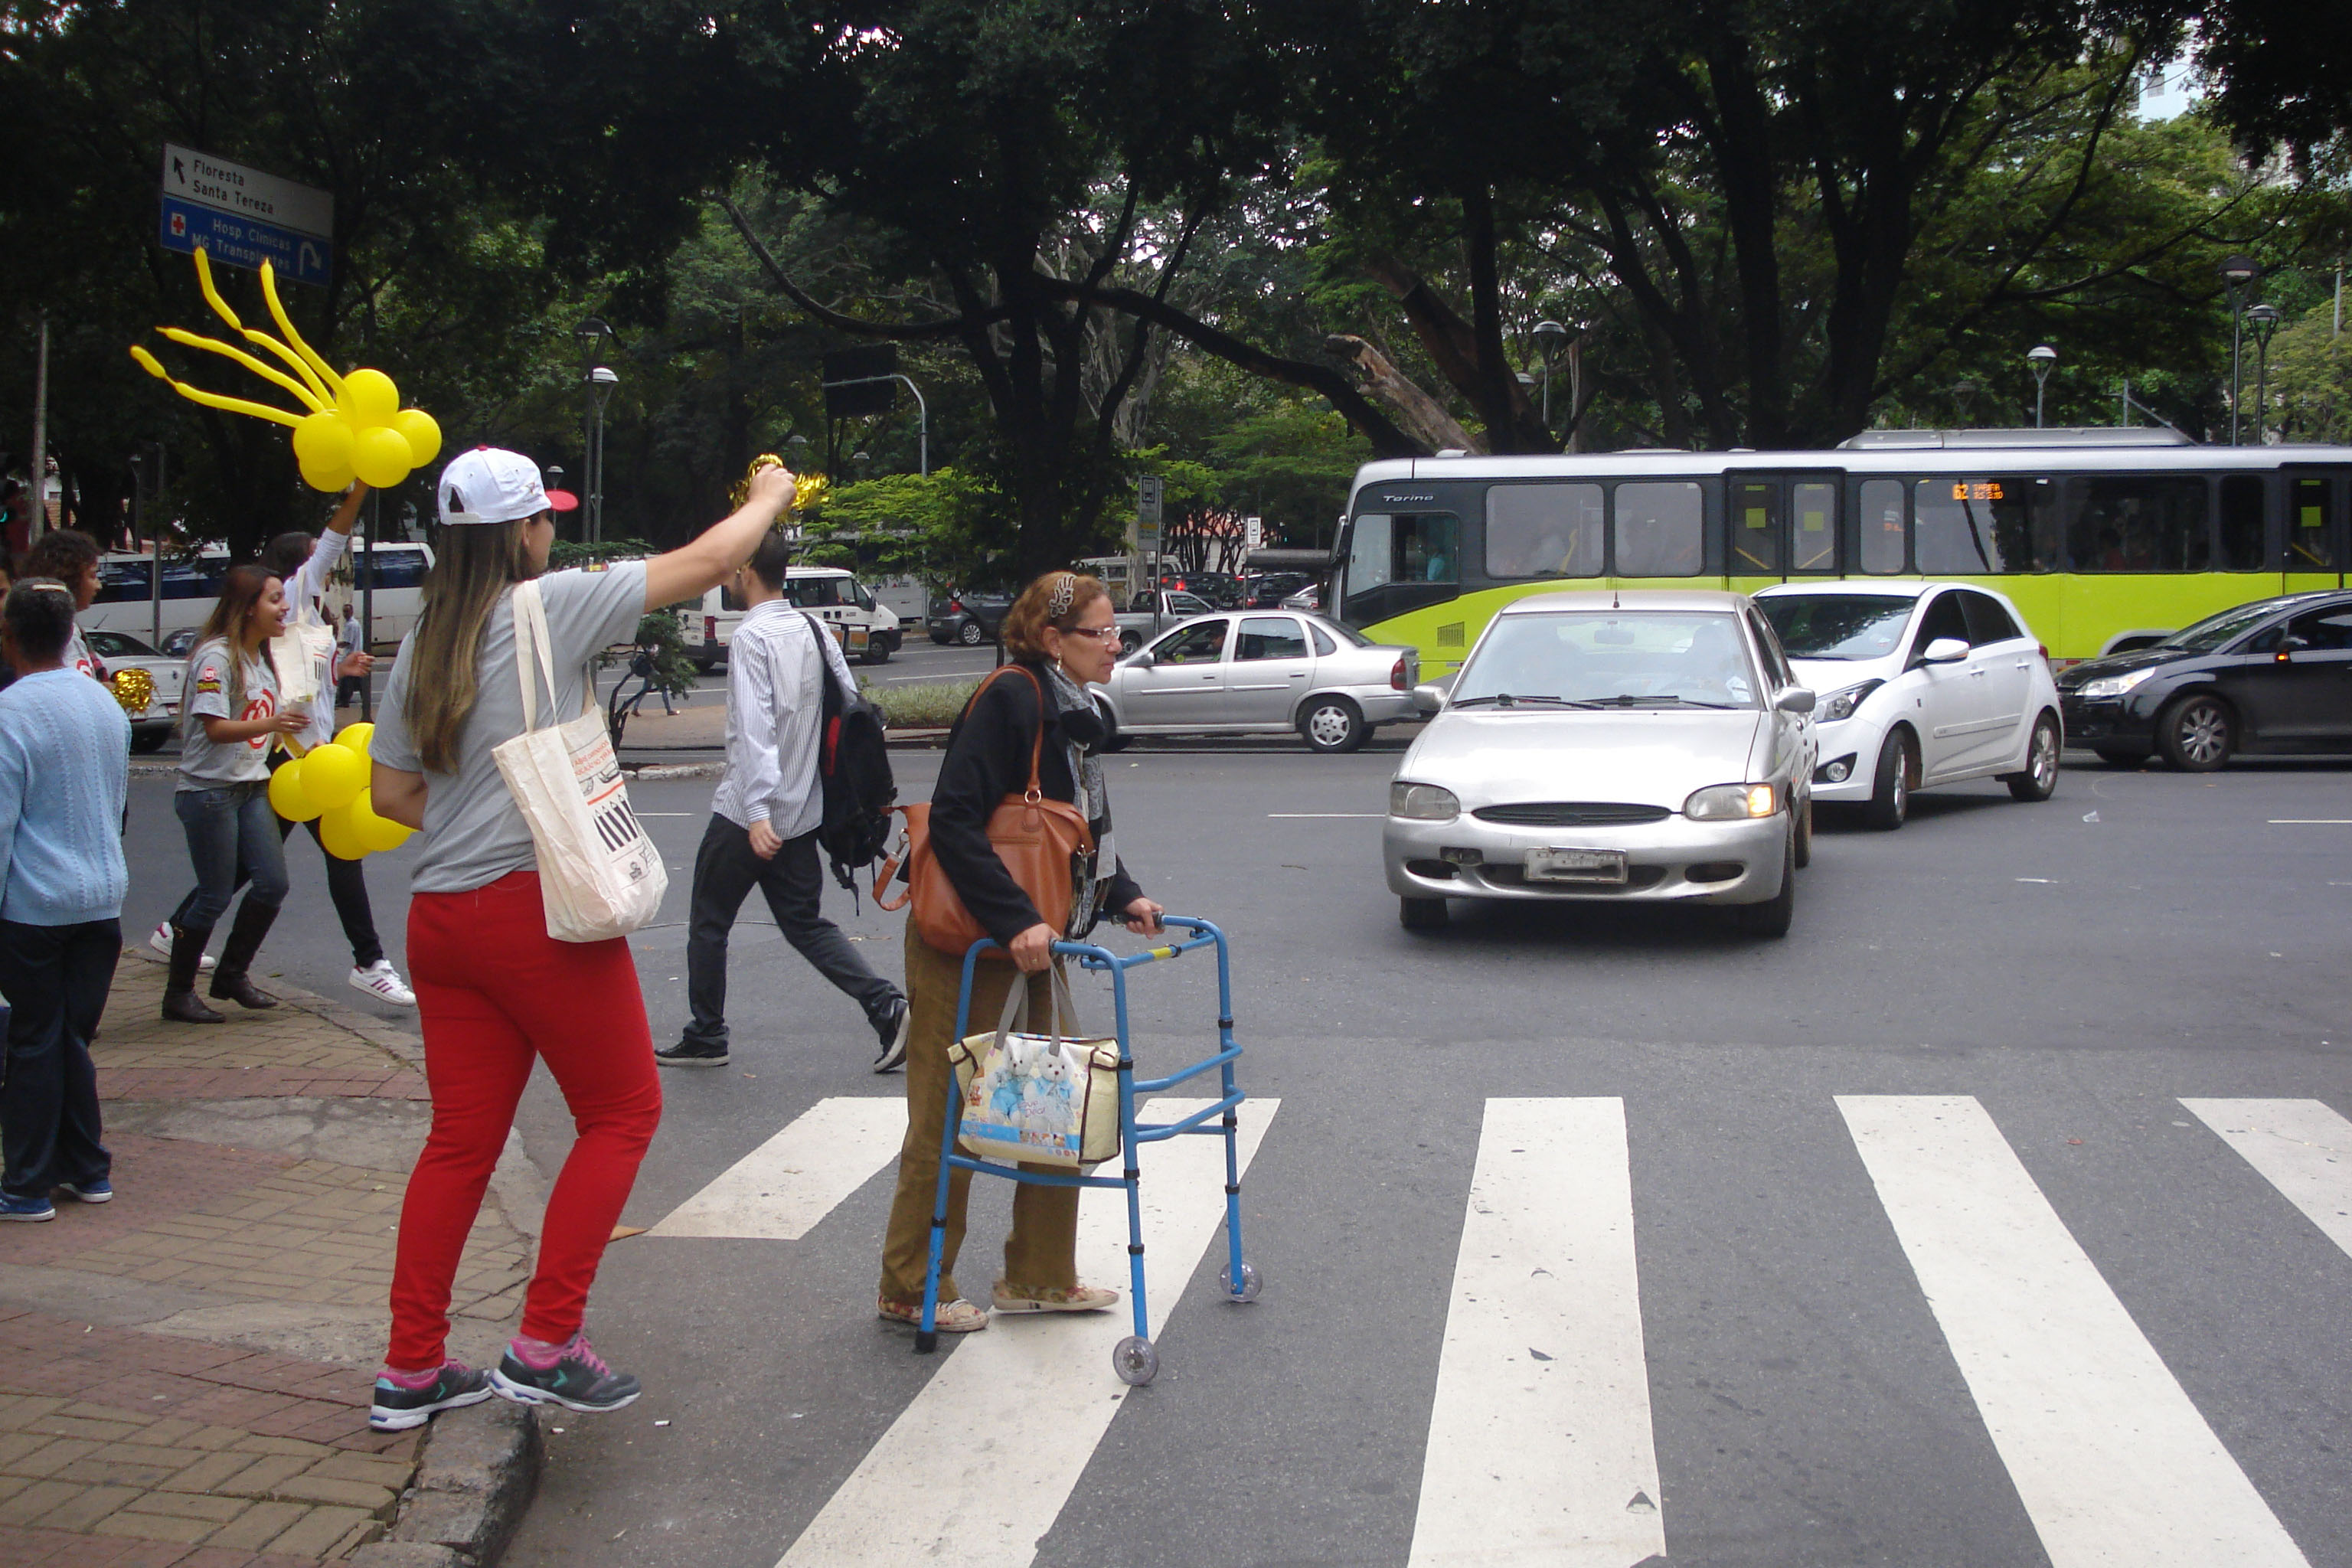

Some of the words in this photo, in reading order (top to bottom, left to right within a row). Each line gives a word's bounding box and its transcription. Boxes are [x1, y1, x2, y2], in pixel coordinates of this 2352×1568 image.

[194, 159, 245, 186] Floresta
[193, 180, 227, 201] Santa
[234, 191, 274, 214] Tereza
[191, 232, 210, 249] MG
[1952, 483, 1969, 500] 62
